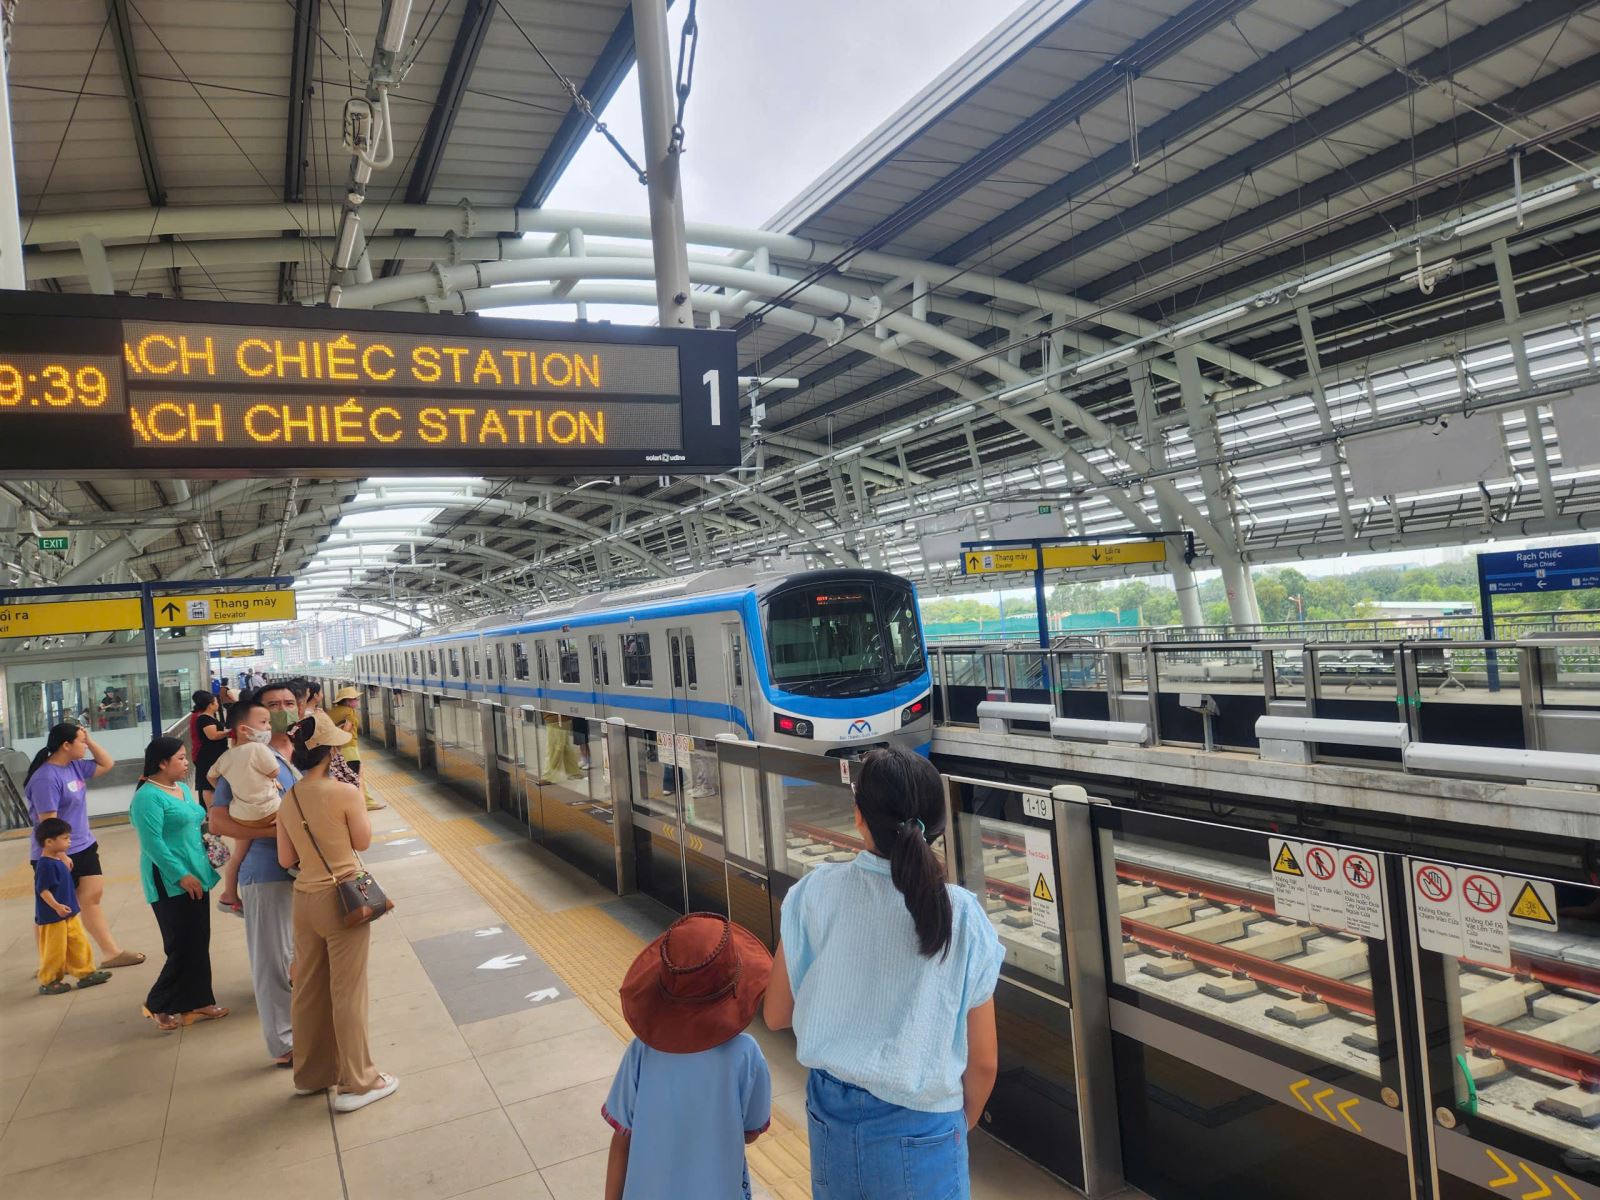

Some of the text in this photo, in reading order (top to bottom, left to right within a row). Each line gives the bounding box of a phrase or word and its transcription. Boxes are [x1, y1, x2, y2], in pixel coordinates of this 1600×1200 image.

[411, 346, 601, 387] STATION
[703, 370, 720, 425] 1
[418, 407, 605, 444] STATION
[43, 539, 63, 548] EXIT
[213, 596, 277, 609] Thang máy
[15, 612, 29, 620] ra
[214, 611, 247, 619] Elevator
[1026, 797, 1046, 816] 1-19
